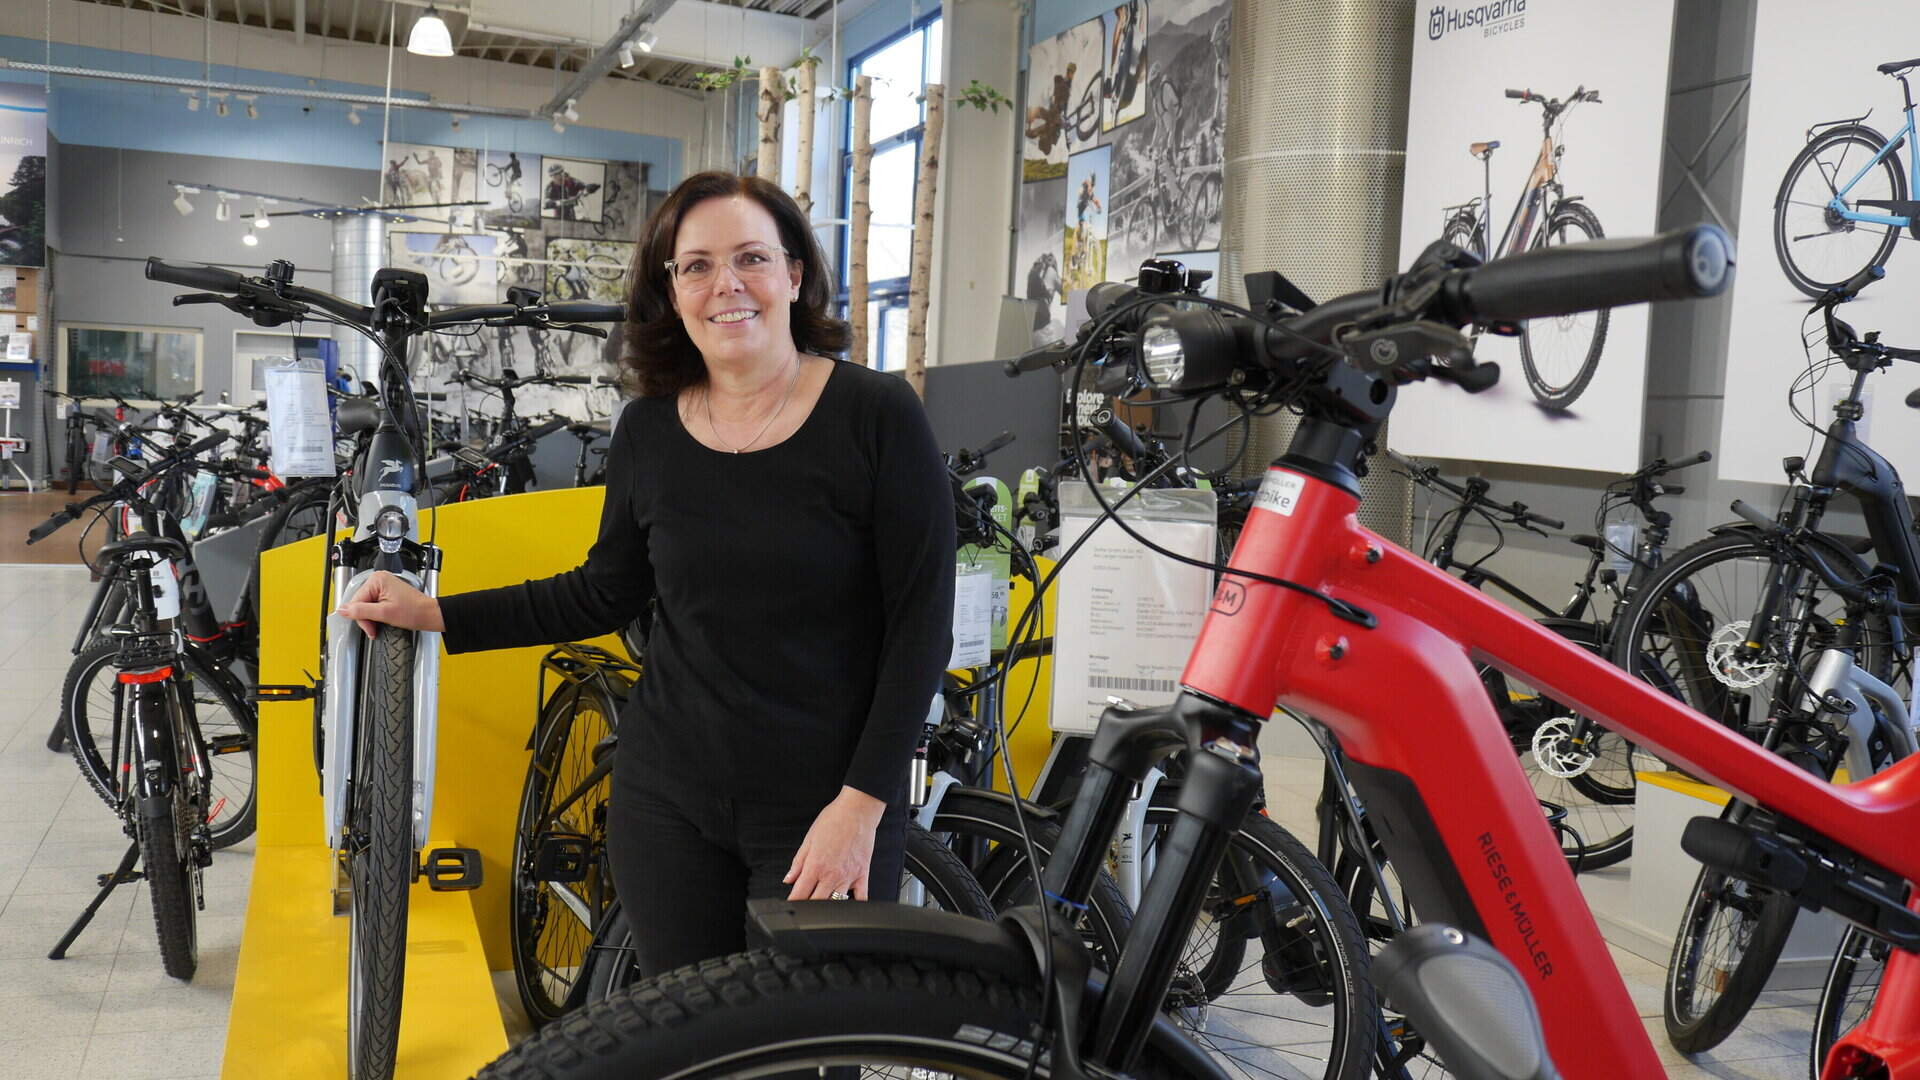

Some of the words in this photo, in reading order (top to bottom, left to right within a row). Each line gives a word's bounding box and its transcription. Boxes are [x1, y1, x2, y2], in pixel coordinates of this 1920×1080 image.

[1447, 0, 1525, 32] Husqvarna
[1484, 17, 1525, 38] BICYCLES
[1066, 388, 1104, 405] Eplore
[1477, 832, 1512, 892] RIESE
[1509, 903, 1553, 981] MÜLLER
